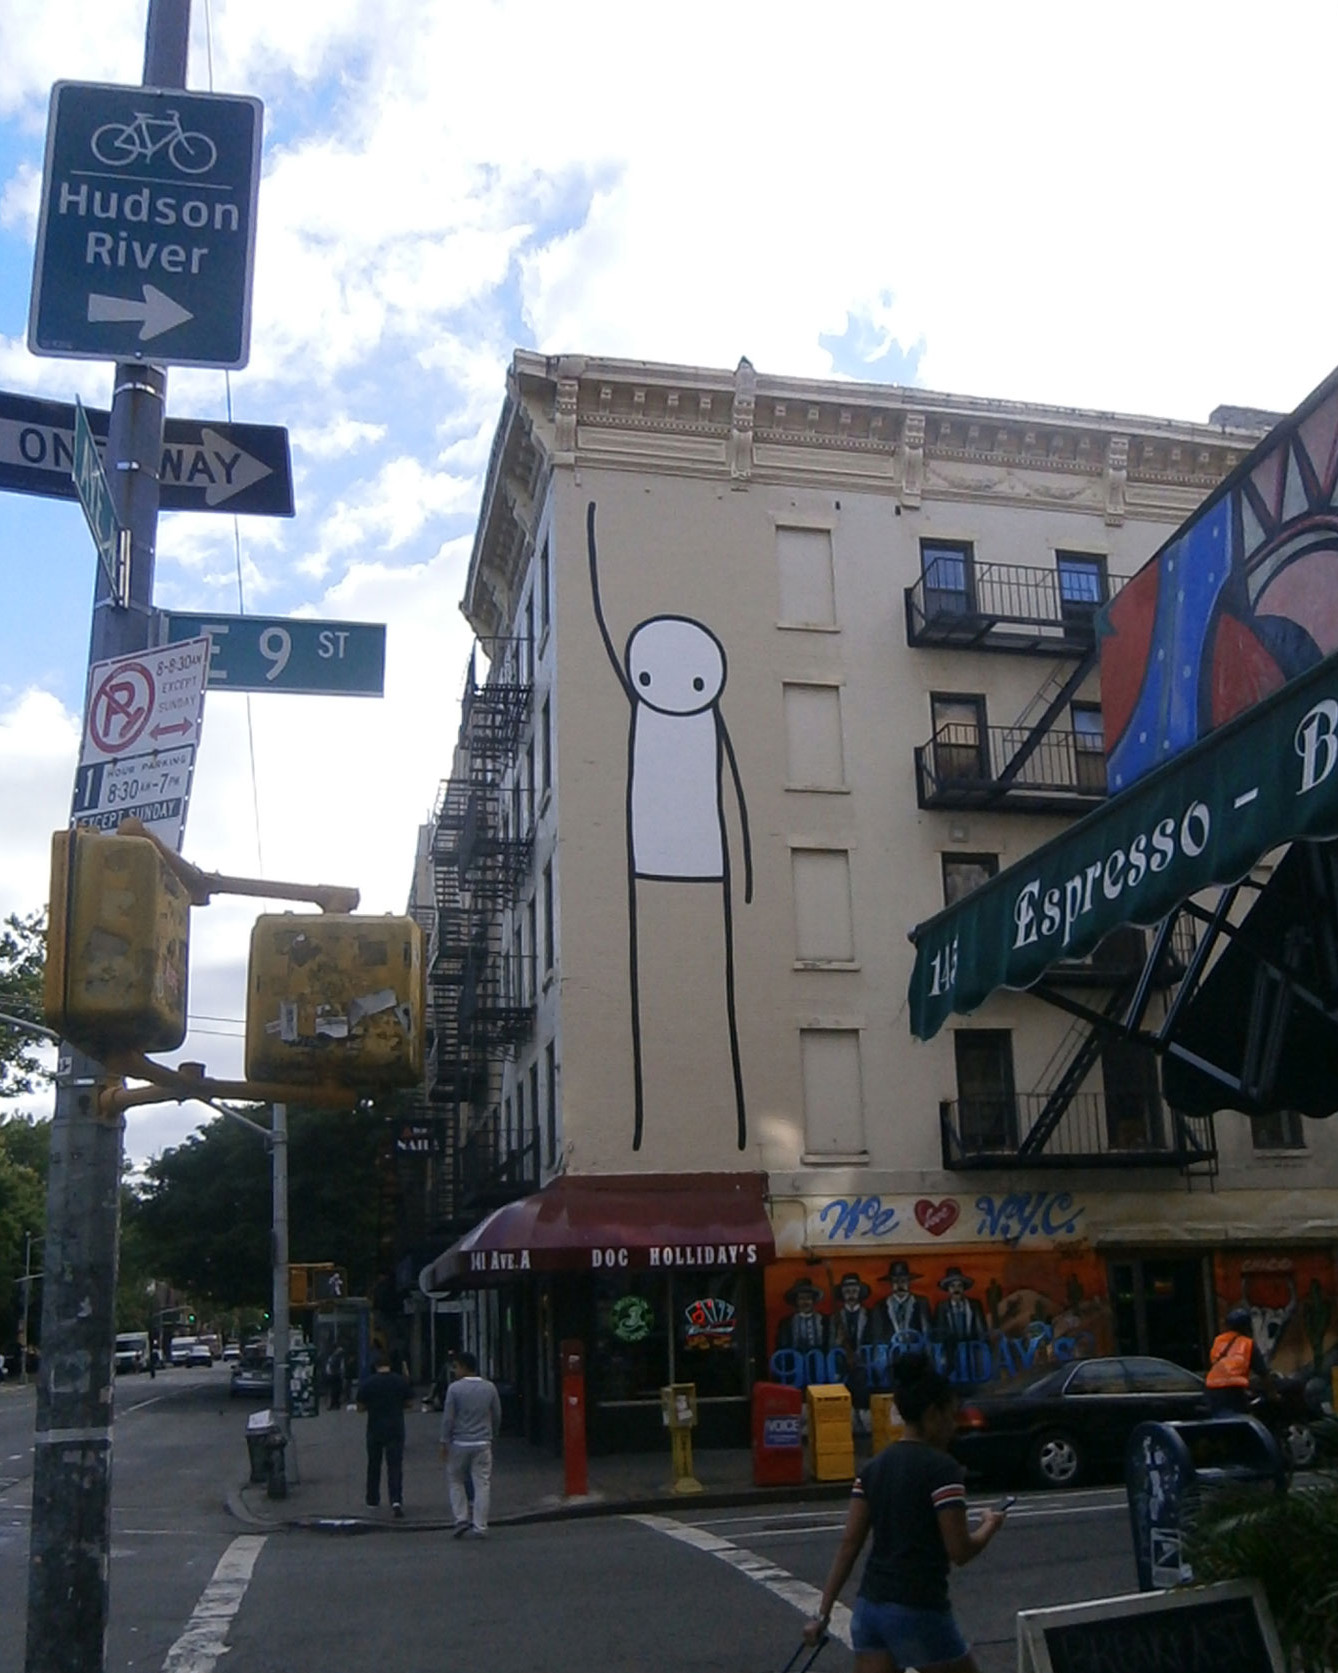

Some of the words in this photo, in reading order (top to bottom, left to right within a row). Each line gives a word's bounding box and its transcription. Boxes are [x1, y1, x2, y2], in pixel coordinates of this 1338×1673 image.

[58, 181, 240, 232] Hudson
[85, 231, 210, 274] River
[258, 626, 292, 682] 9
[317, 631, 350, 659] ST
[161, 675, 198, 694] EXCEPT
[158, 695, 197, 714] SUNDAY
[107, 765, 136, 779] HOUR
[141, 754, 187, 771] PARKING
[85, 767, 95, 808] 1
[128, 799, 177, 821] SUNDAY
[1012, 798, 1211, 950] Espresso
[820, 1195, 900, 1240] We
[520, 1249, 532, 1270] A
[591, 1248, 630, 1268] DOC
[649, 1243, 758, 1267] HOLLIDAY'S
[766, 1419, 799, 1432] VOICE
